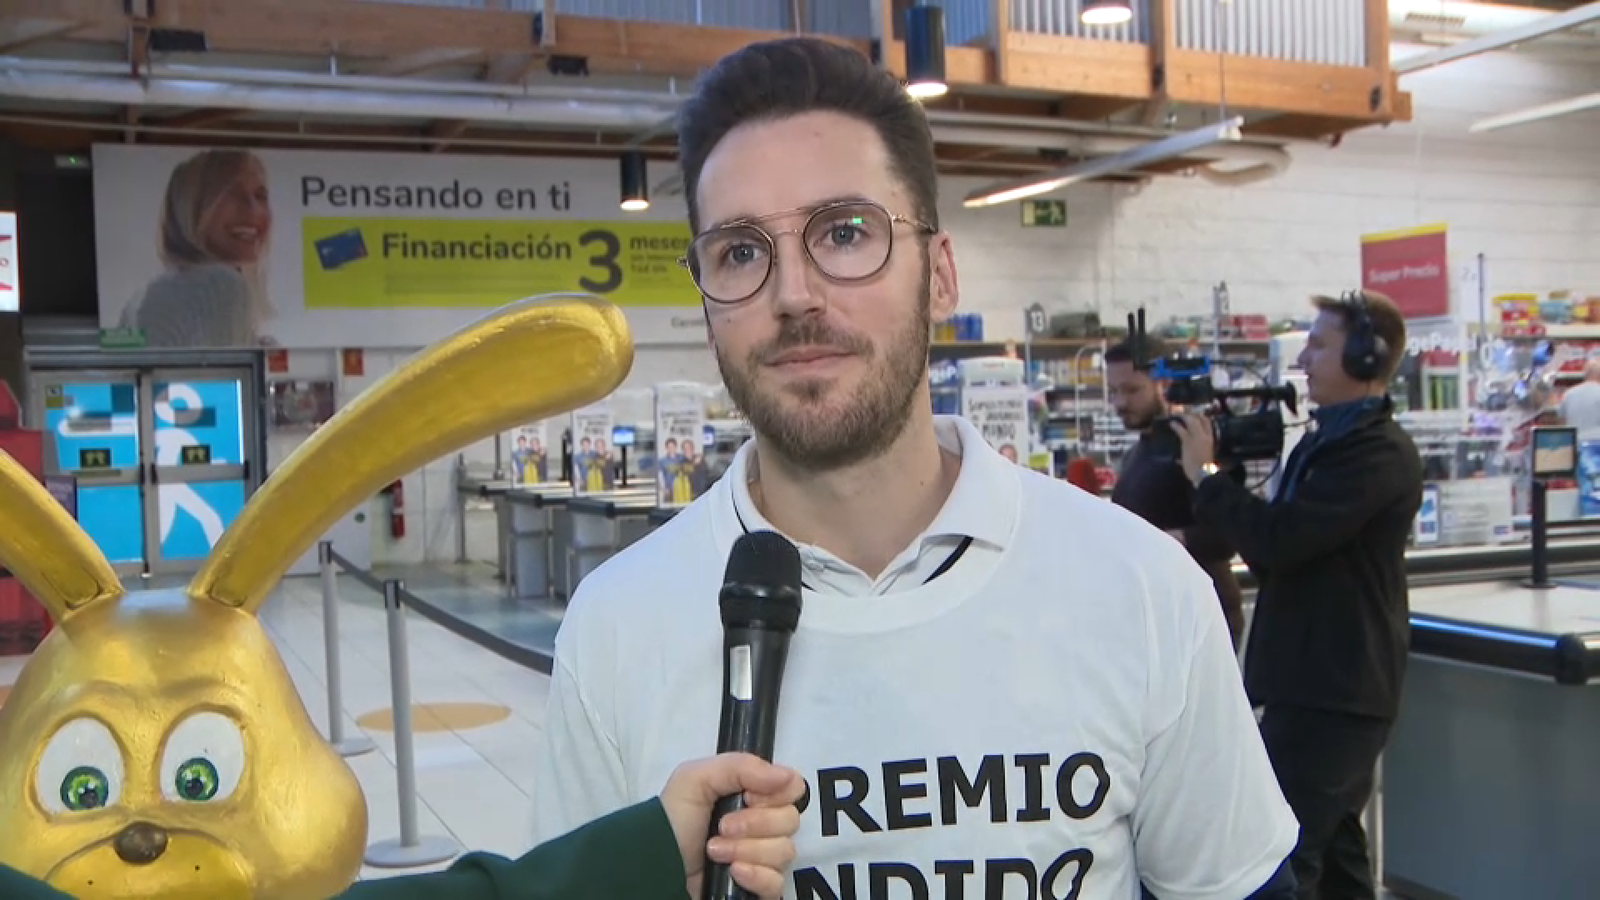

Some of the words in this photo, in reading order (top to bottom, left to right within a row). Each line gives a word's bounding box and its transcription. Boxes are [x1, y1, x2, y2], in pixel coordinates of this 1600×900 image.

[301, 176, 483, 209] Pensando
[496, 187, 536, 210] en
[548, 181, 571, 211] ti
[381, 232, 572, 260] Financiación
[578, 229, 623, 294] 3
